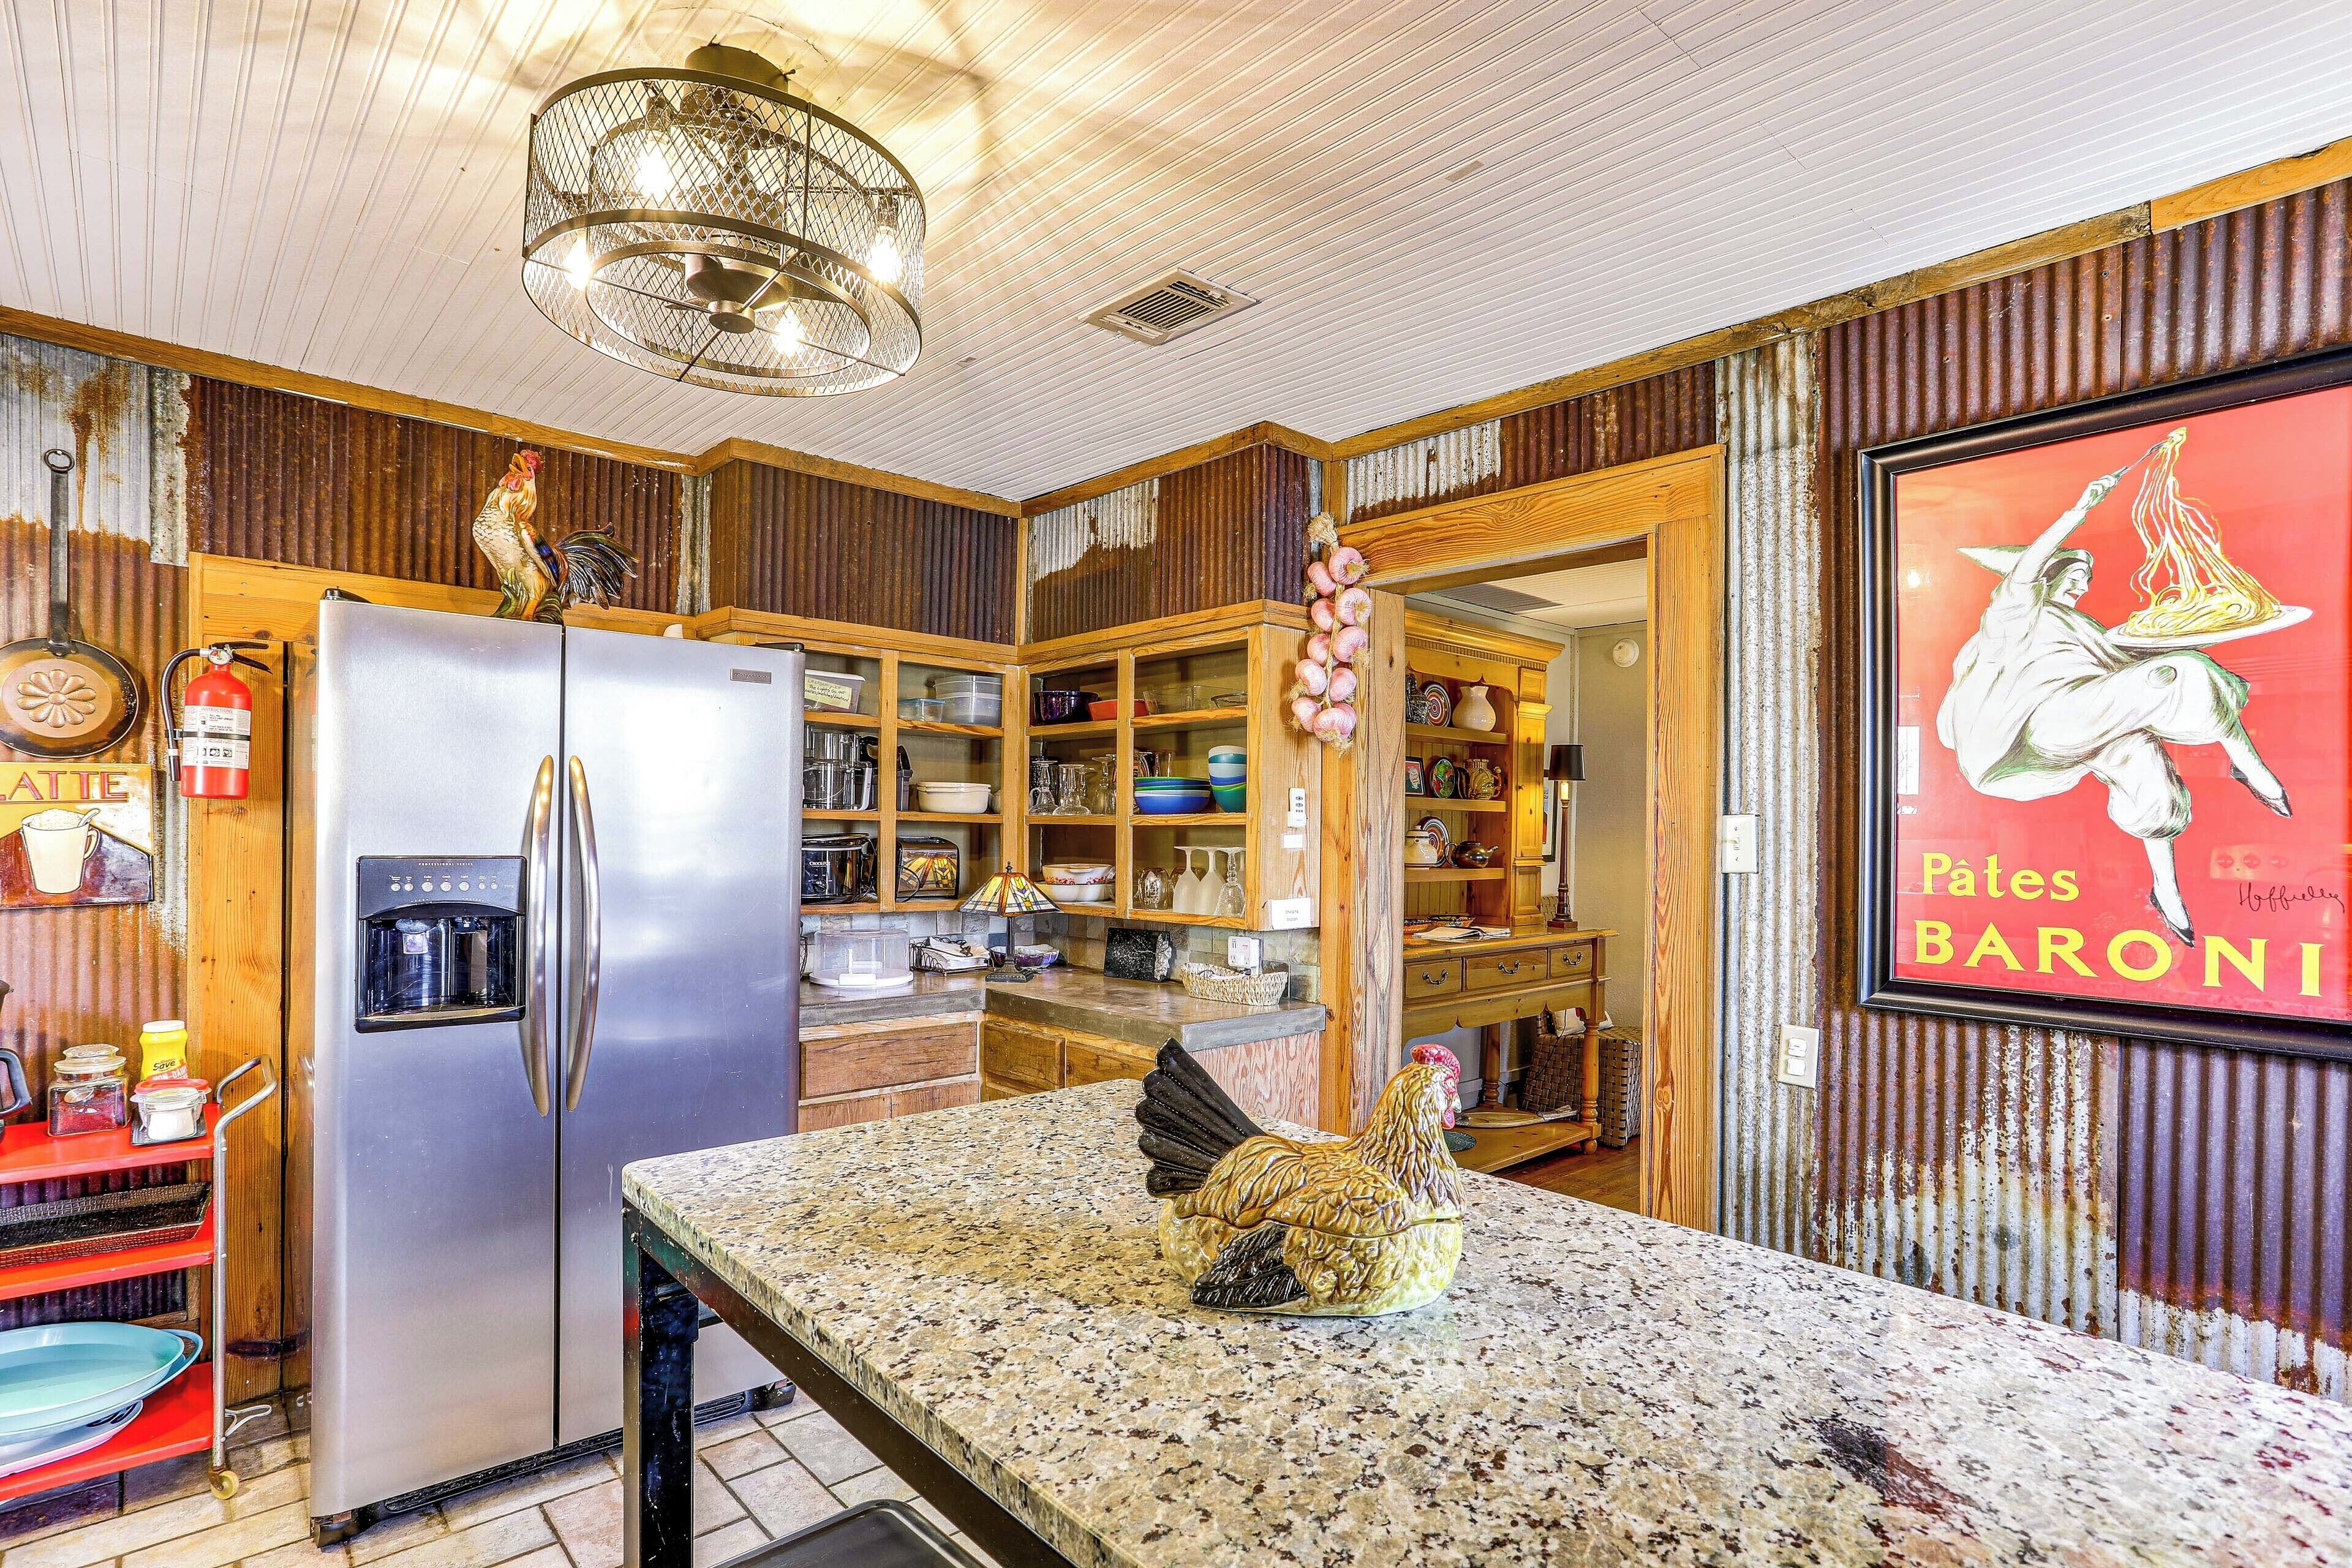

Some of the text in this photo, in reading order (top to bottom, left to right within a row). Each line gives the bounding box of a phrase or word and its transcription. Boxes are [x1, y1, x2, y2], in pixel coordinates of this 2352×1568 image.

[0, 771, 129, 801] ATTE
[1921, 852, 2080, 902] Pâtes
[1915, 919, 2325, 997] BARONI
[153, 1060, 176, 1071] Save
